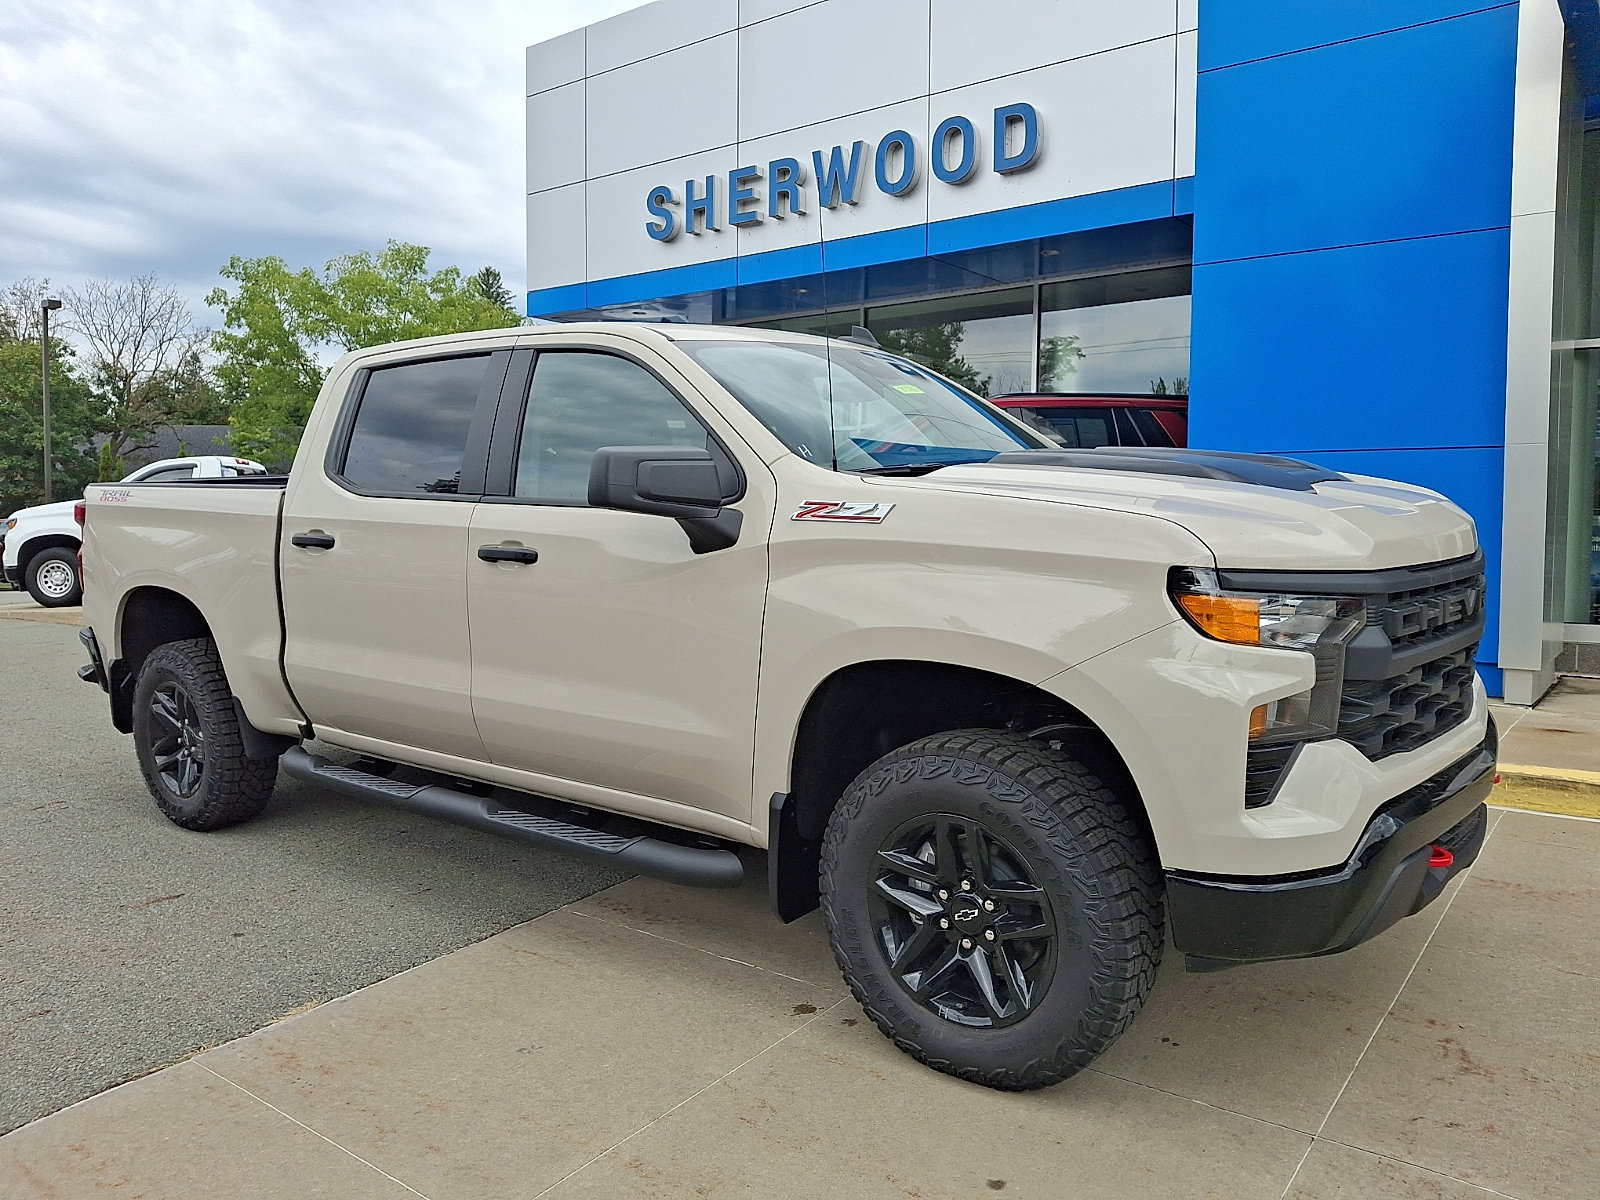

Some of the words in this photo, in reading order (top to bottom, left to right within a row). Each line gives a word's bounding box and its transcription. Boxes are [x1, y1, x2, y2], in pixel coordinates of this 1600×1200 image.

[646, 102, 1044, 242] SHERWOOD
[100, 489, 133, 497] TRAIL
[791, 500, 896, 524] Z71
